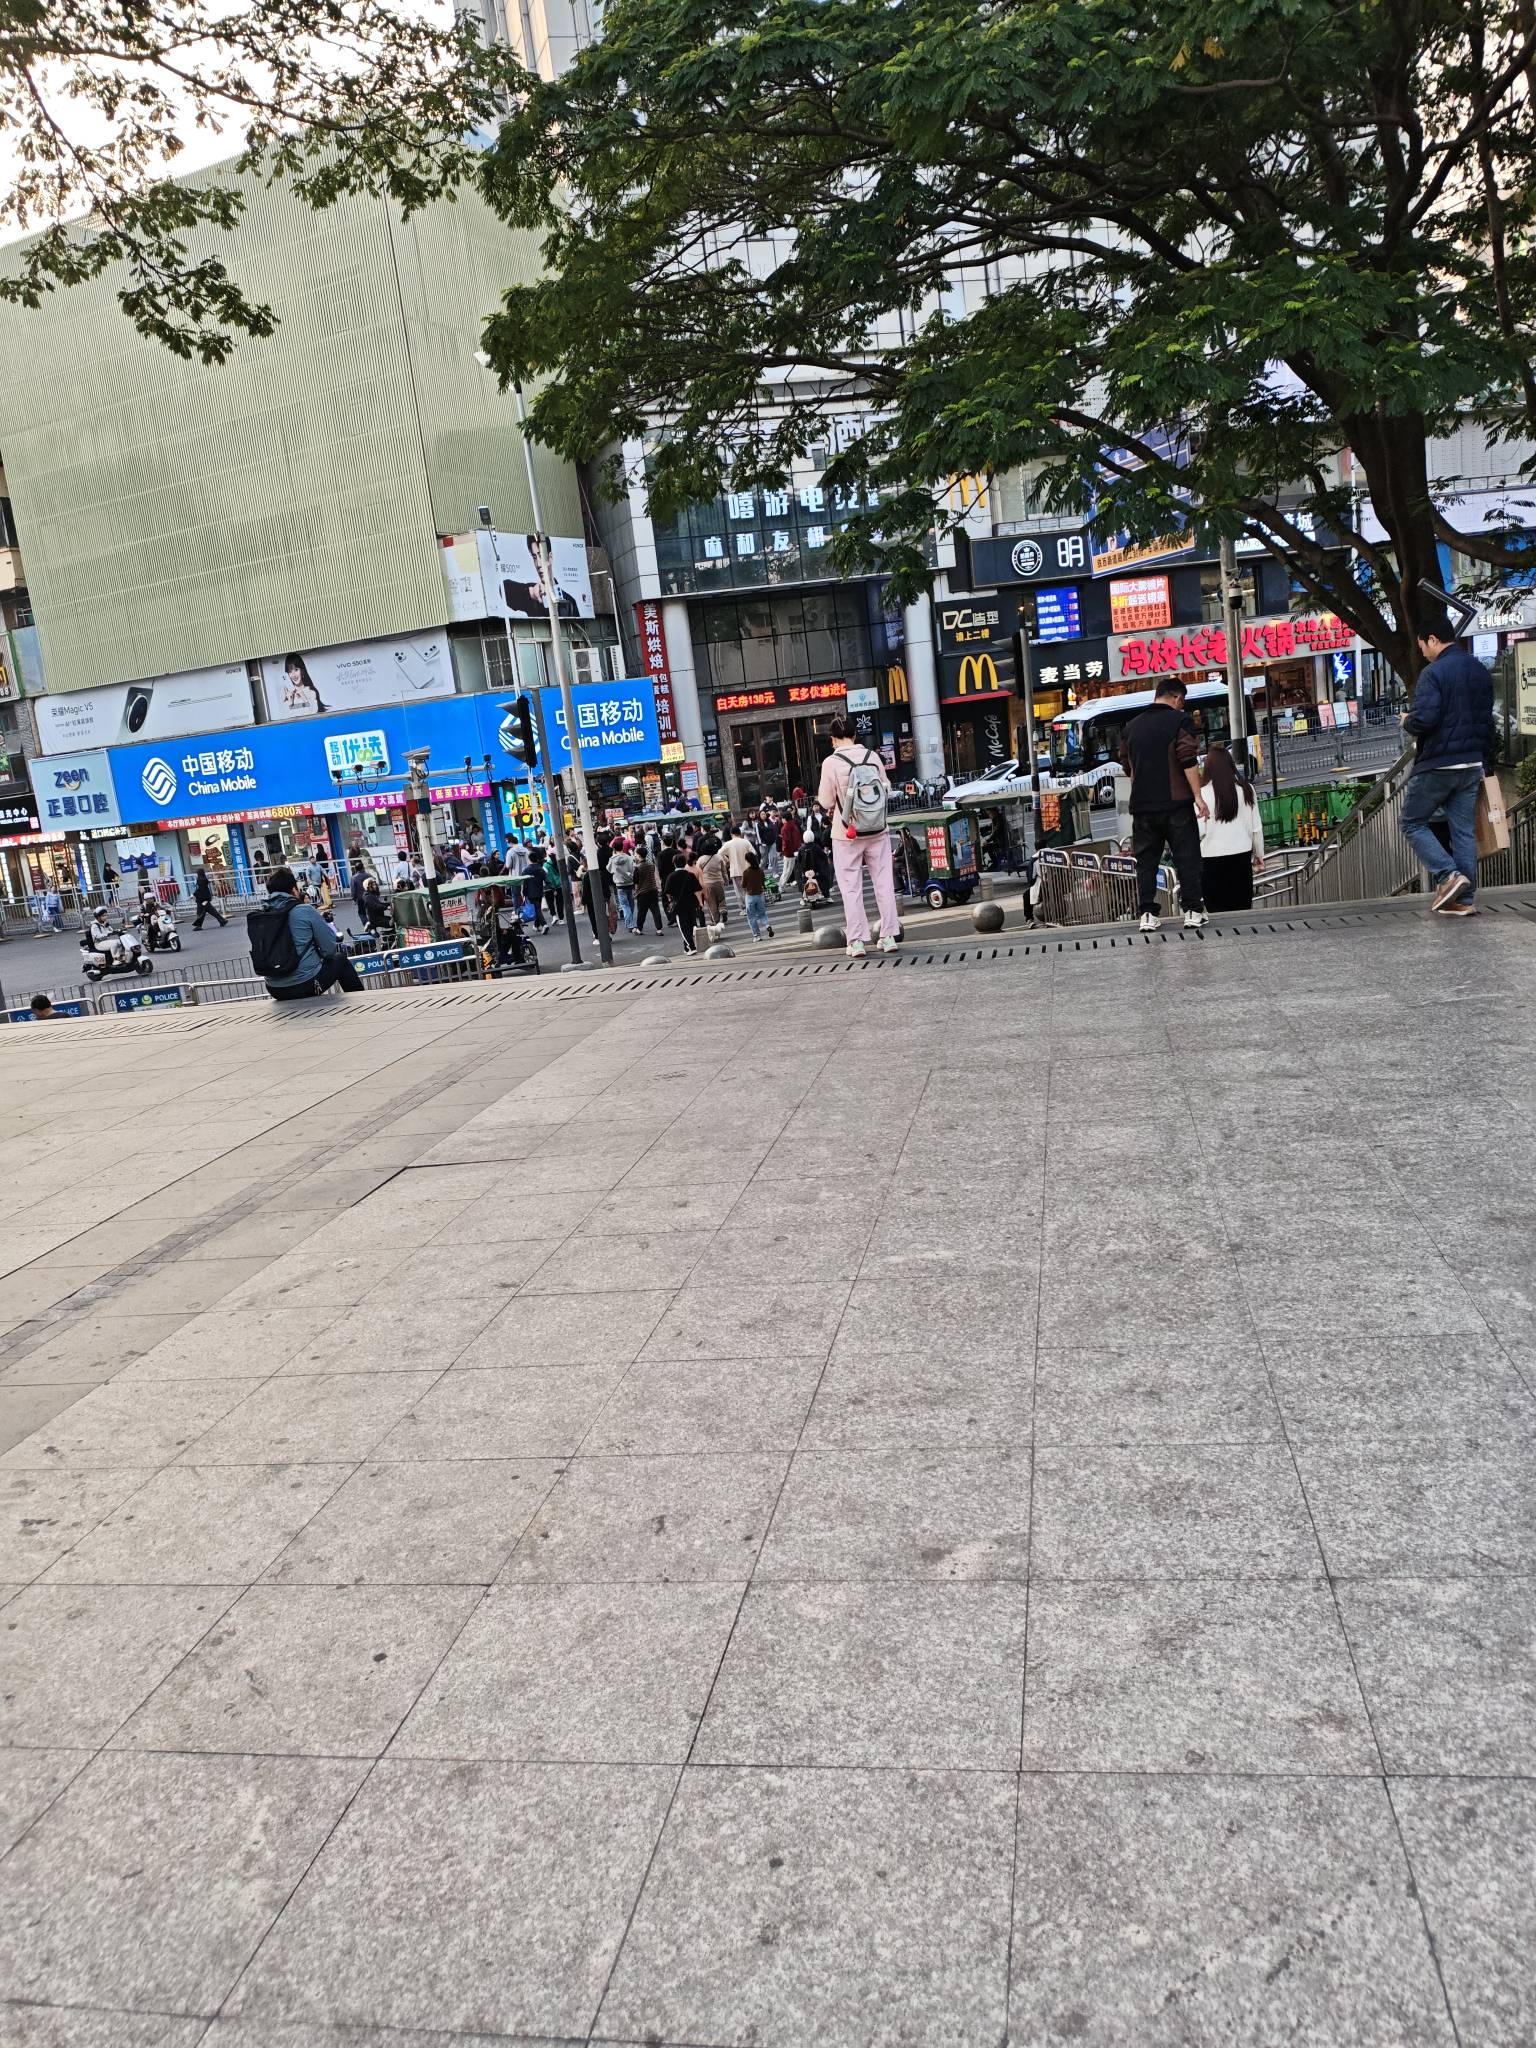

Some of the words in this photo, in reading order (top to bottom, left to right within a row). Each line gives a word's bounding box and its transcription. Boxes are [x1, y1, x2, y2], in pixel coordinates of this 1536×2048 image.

[1056, 535, 1085, 568] 明
[643, 603, 665, 669] 美斯烘焙
[1119, 622, 1296, 676] 冯校长老火锅
[1039, 660, 1104, 684] 麦当劳
[602, 726, 645, 746] Mobile
[181, 746, 254, 778] 中国移动
[188, 779, 219, 797] China
[220, 774, 257, 793] Mobile
[401, 953, 422, 964] 公安
[436, 947, 460, 957] POLICE
[118, 998, 139, 1008] 公安
[154, 992, 179, 1002] POLICE
